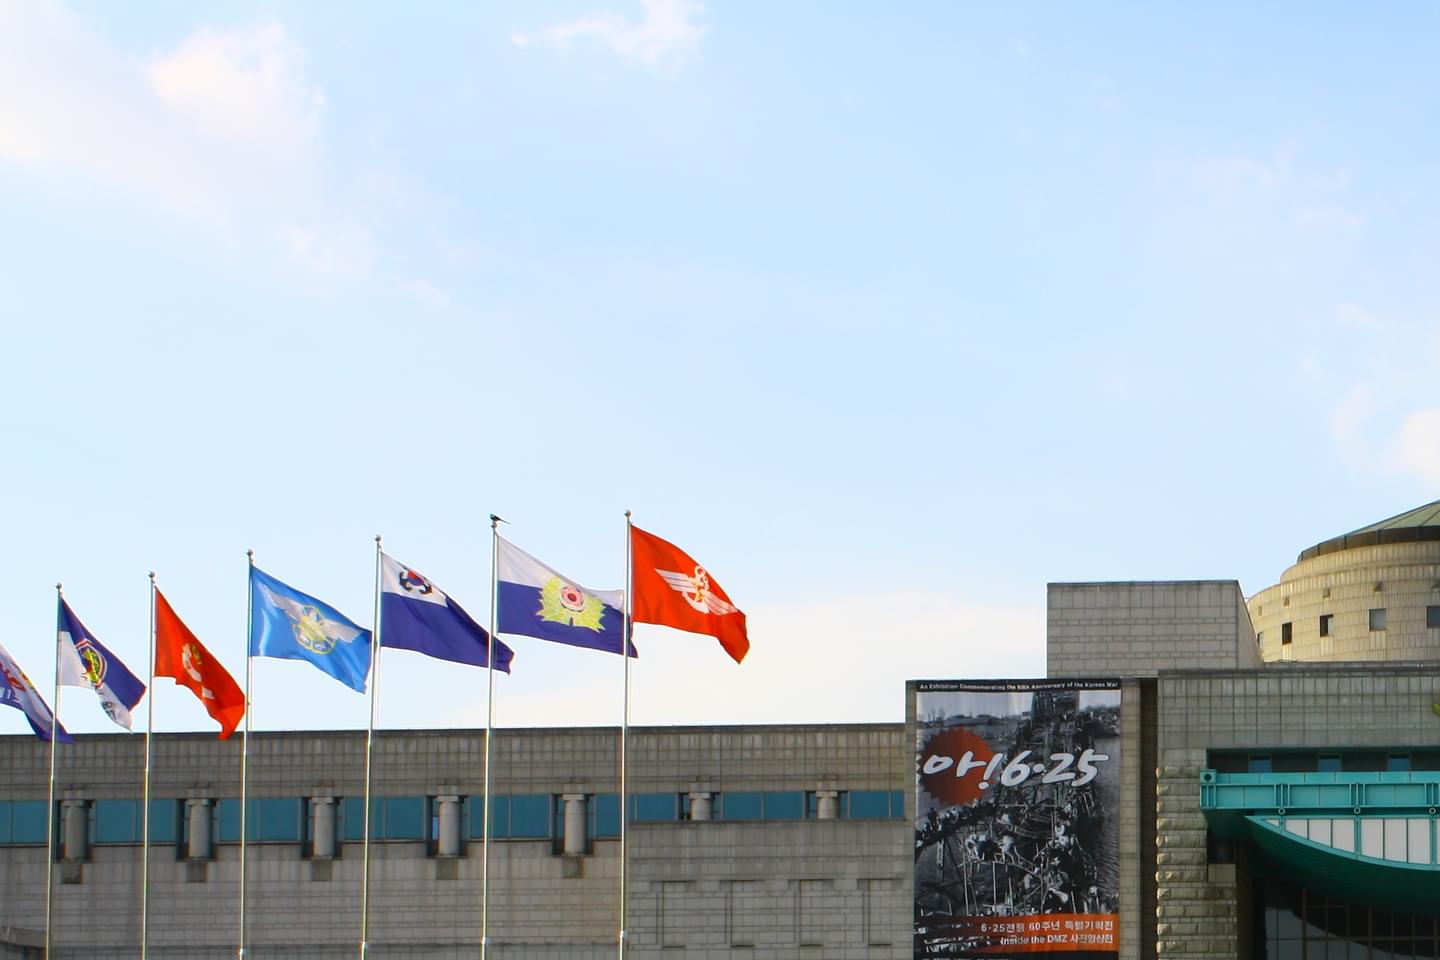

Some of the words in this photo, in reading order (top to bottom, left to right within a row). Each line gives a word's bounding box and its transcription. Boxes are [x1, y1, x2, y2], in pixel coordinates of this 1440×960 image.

[1031, 682, 1066, 690] Anniversary
[1028, 920, 1061, 931] 60주년
[1000, 935, 1029, 945] Inside
[1031, 935, 1045, 944] the
[1047, 934, 1068, 943] DMZ
